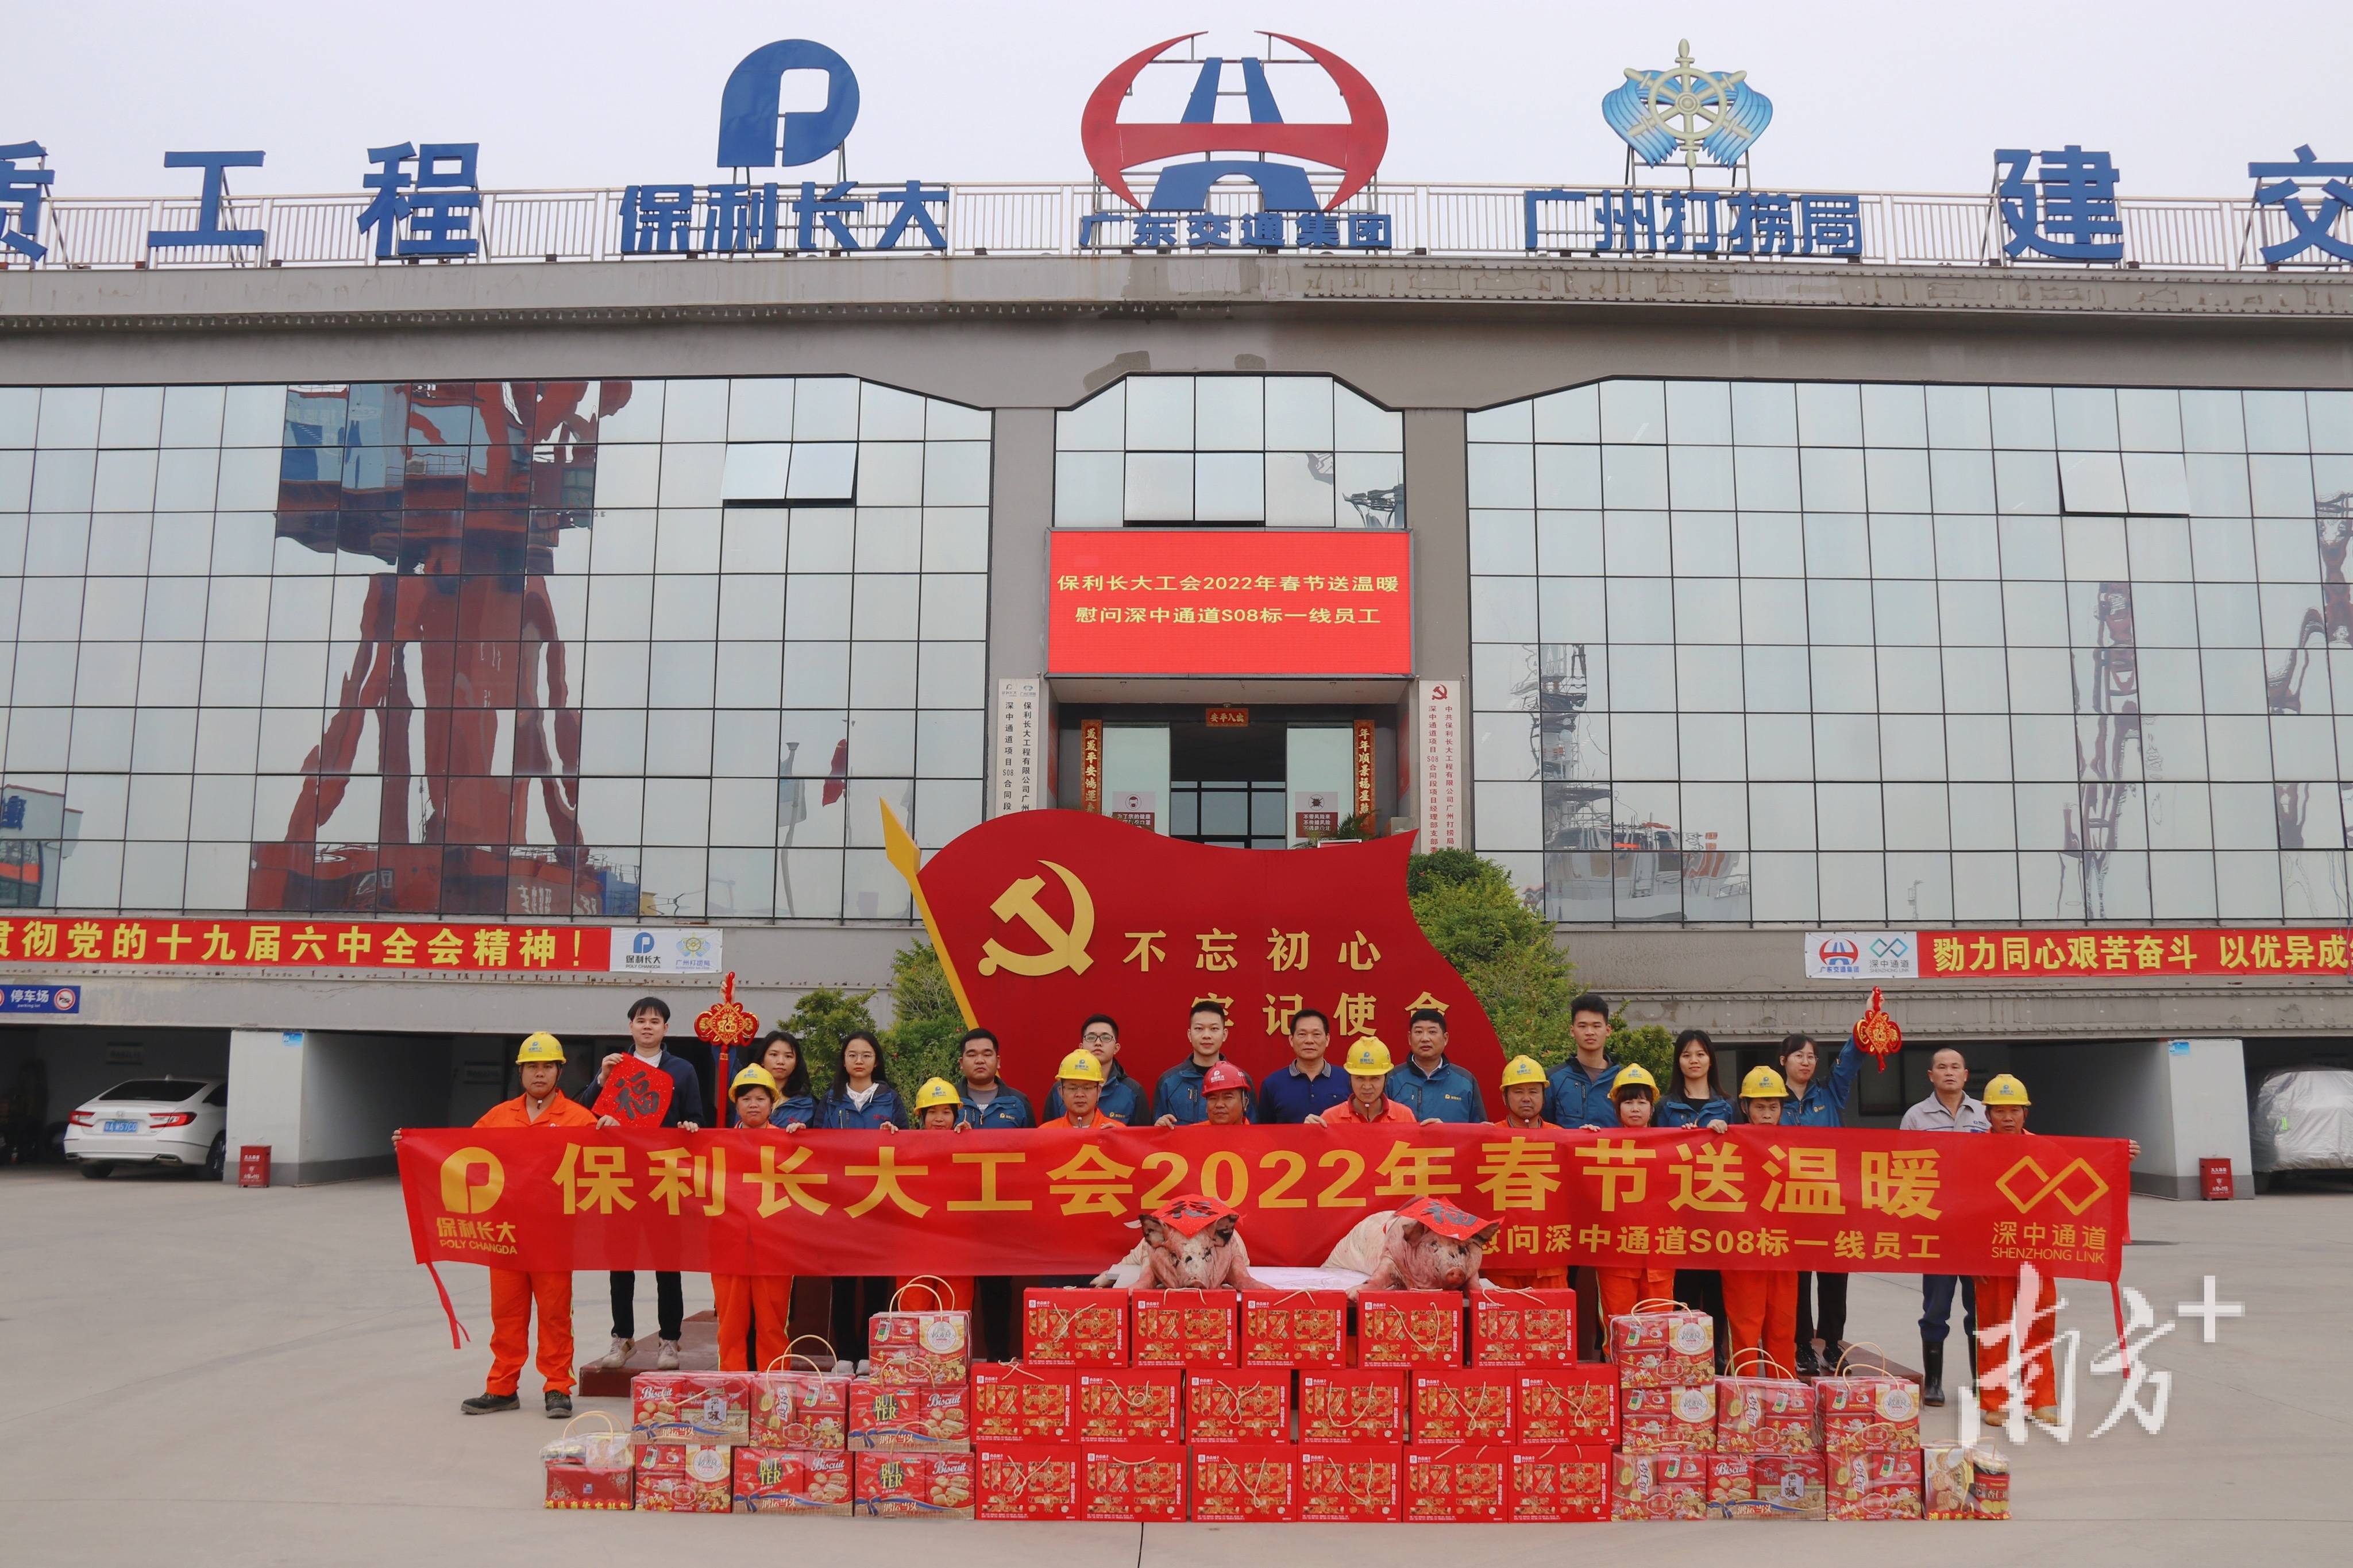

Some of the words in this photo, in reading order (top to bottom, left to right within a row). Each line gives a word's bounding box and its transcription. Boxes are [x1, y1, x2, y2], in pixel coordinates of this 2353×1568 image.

[619, 180, 950, 253] 保利长大
[1525, 189, 1862, 254] 广州打捞局
[1079, 212, 1392, 248] 广东交通集团
[1056, 575, 1399, 593] 保利长大工会2022年春节送温暖
[1075, 607, 1381, 624] 慰问深中通道S08标一线员工
[1122, 928, 1382, 972] 不忘初心
[2219, 934, 2353, 969] 以优异成
[626, 955, 661, 964] 保利长大
[1869, 960, 1909, 968] 深中通道
[10, 989, 49, 1003] 停车场
[615, 1070, 660, 1121] 福
[552, 1136, 1943, 1222] 保利长大工会2022年春节送温暖
[436, 1217, 516, 1244] 保利长大
[1992, 1221, 2107, 1250] 深中通道
[439, 1239, 466, 1250] POLY
[468, 1240, 518, 1255] CHANGDA
[1991, 1247, 2073, 1262] SHENZHONG
[2076, 1248, 2105, 1264] LINK
[927, 1393, 961, 1408] Biscuit
[875, 1407, 897, 1421] TER
[811, 1457, 844, 1472] Biscuit
[932, 1460, 967, 1474] Biscuit
[1714, 1462, 1749, 1476] Biscuit
[759, 1471, 781, 1485] TER
[880, 1474, 902, 1488] TER
[1737, 1504, 1772, 1515] 鸿运当头
